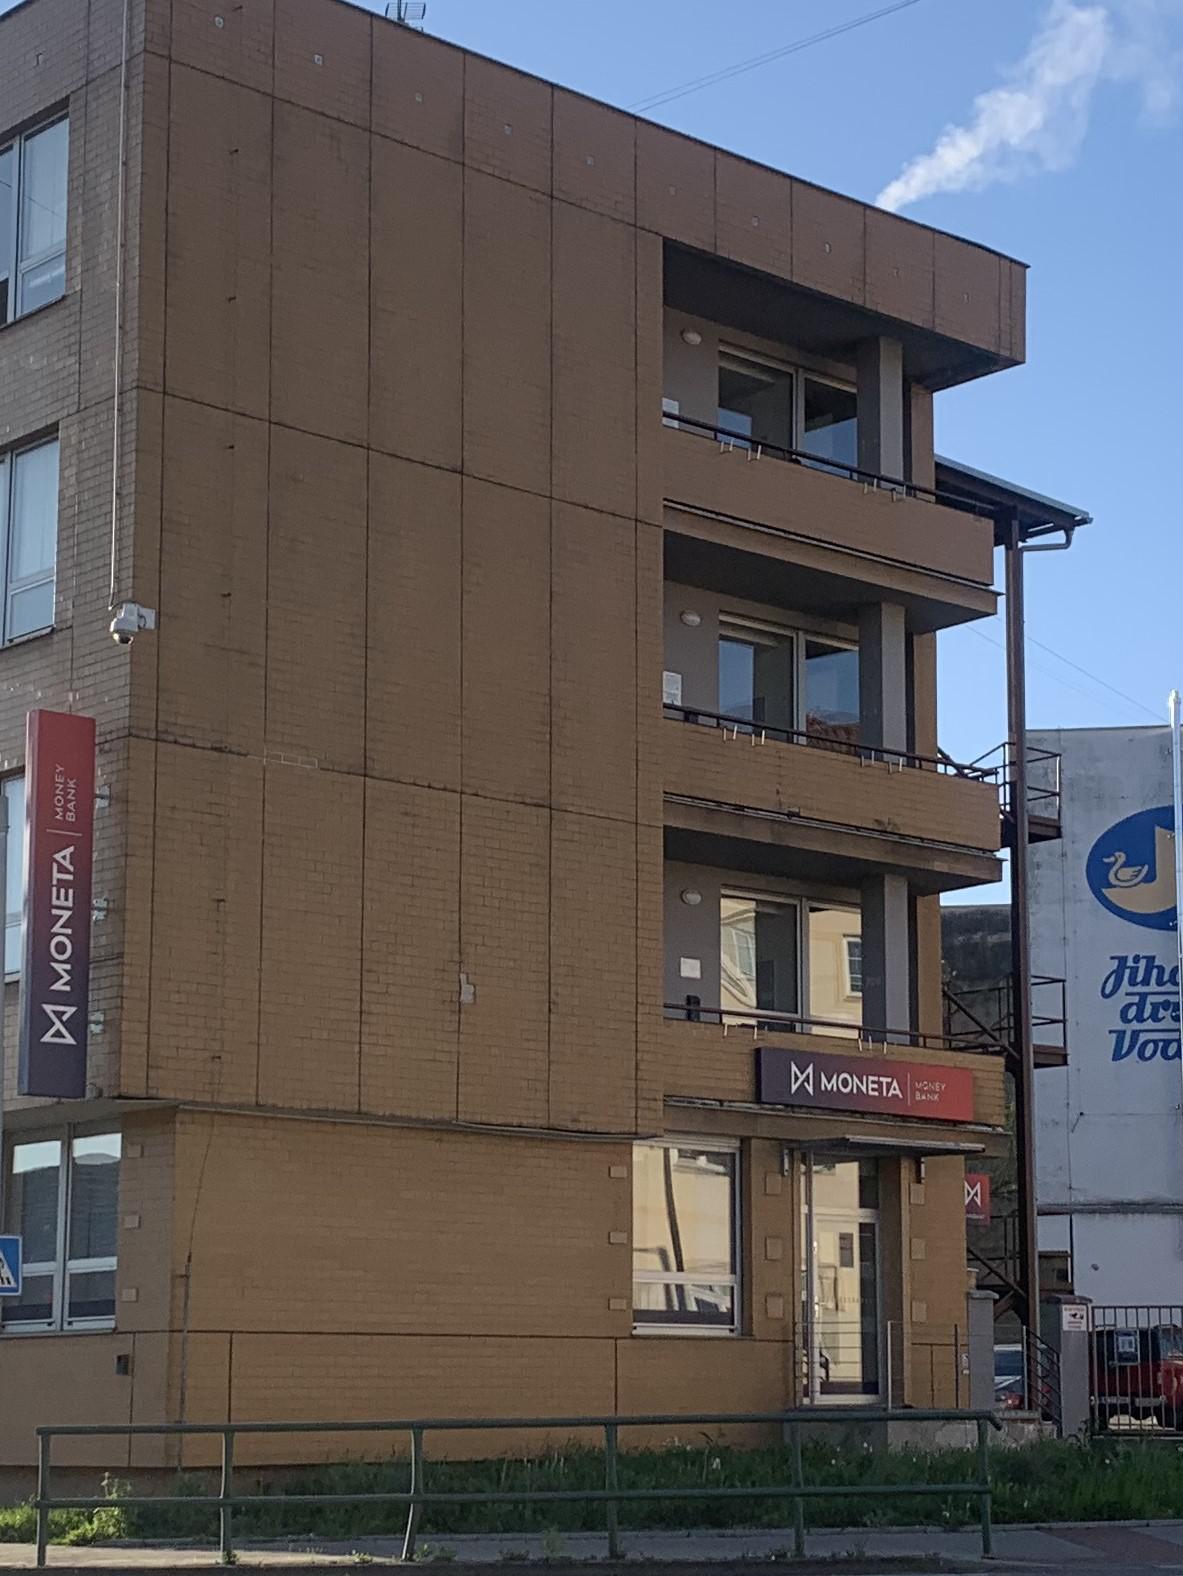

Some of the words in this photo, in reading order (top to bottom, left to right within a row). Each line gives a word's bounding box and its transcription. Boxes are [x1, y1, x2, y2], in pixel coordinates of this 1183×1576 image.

[53, 764, 66, 820] MONEY
[65, 779, 77, 822] BANK
[49, 845, 75, 991] MONETA
[820, 1072, 903, 1098] MONETA
[915, 1080, 946, 1091] MONEY
[915, 1090, 940, 1101] BANK
